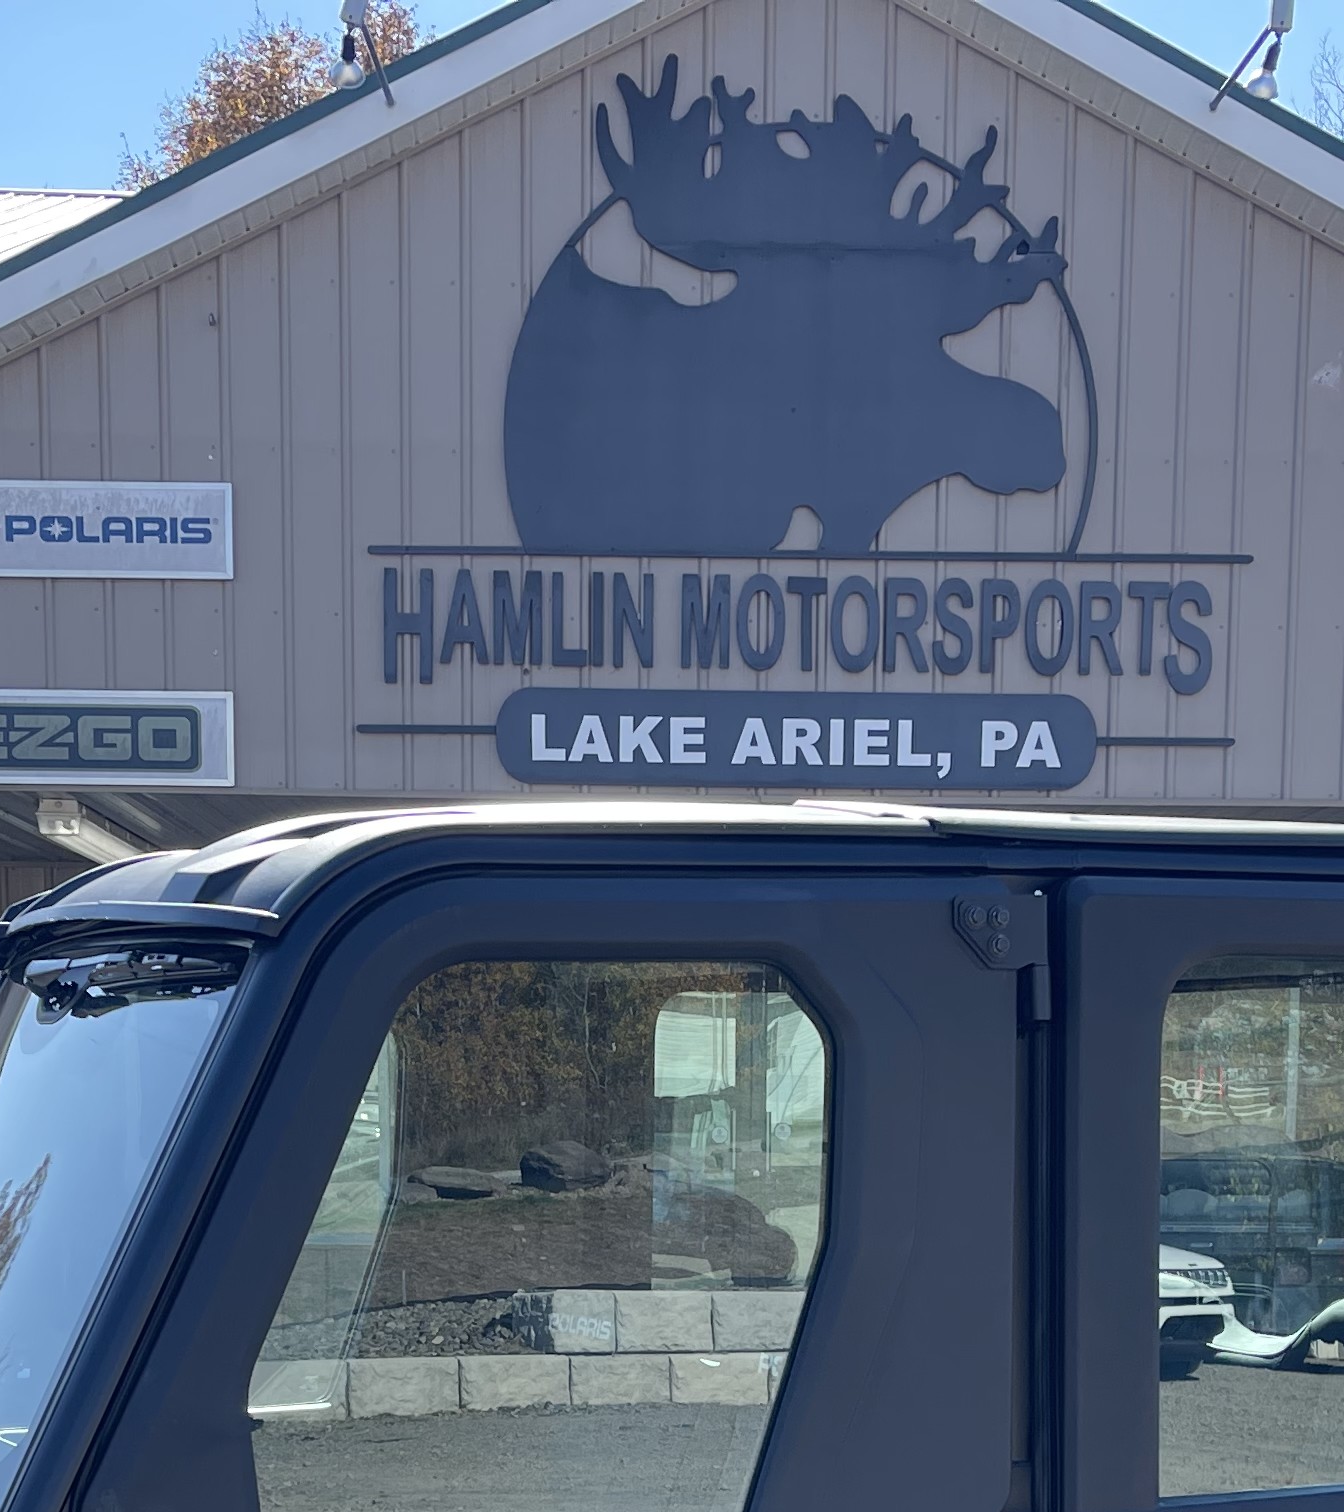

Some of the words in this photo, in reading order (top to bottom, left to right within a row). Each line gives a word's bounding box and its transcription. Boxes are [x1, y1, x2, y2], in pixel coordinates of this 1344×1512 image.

[4, 514, 213, 545] POLARIS
[382, 567, 655, 685] HAMLIN
[680, 573, 1213, 696] MOTORSPORTS
[529, 713, 707, 765] LAKE
[730, 717, 951, 781] ARIEL,
[980, 720, 1062, 769] PA
